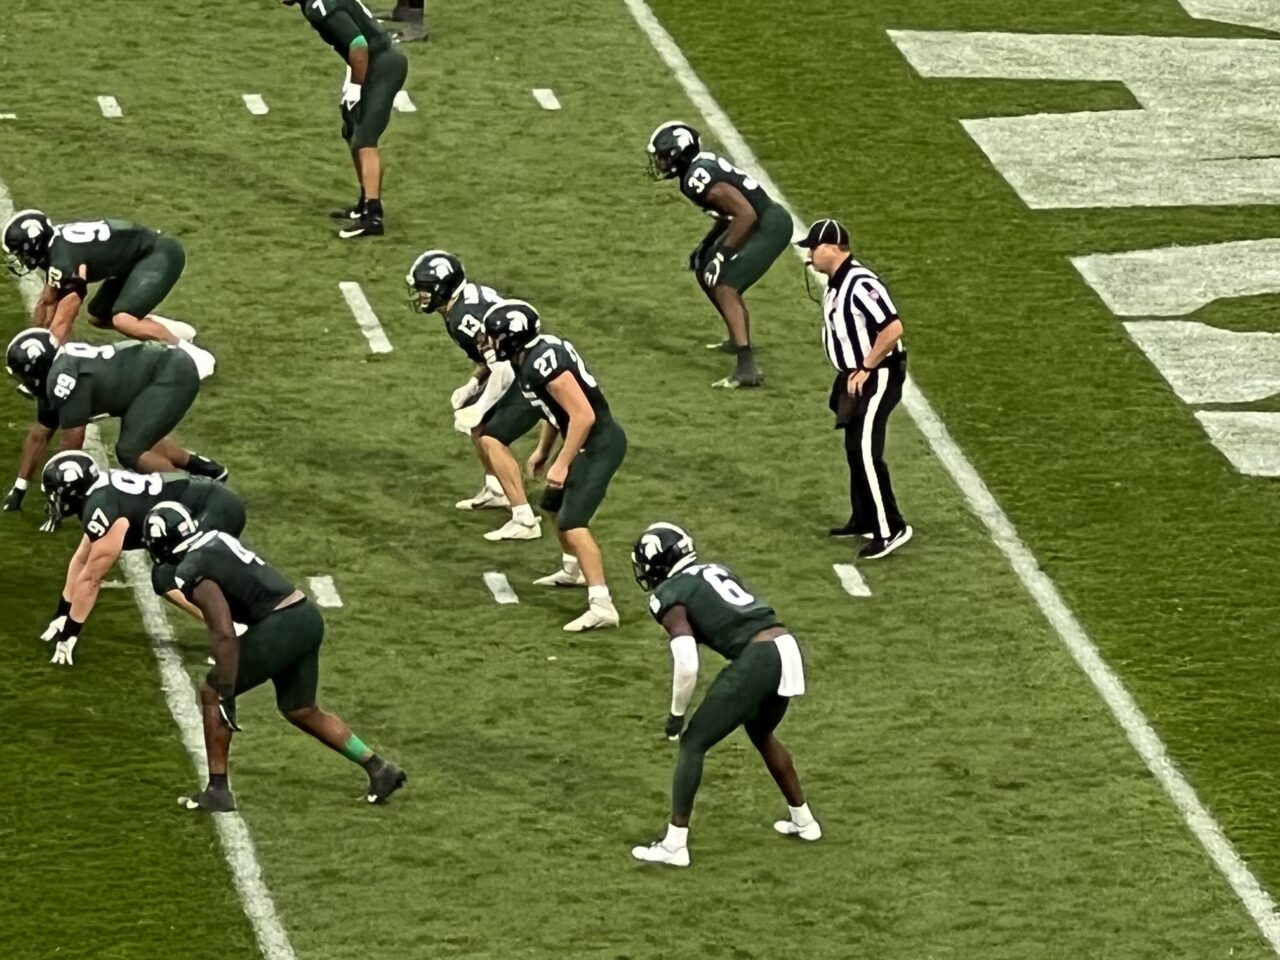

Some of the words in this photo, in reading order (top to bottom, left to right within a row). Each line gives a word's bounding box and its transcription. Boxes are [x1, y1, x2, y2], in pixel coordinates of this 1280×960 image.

[687, 167, 711, 193] 33
[533, 348, 559, 378] 27
[86, 507, 110, 537] 97
[702, 563, 755, 607] 6
